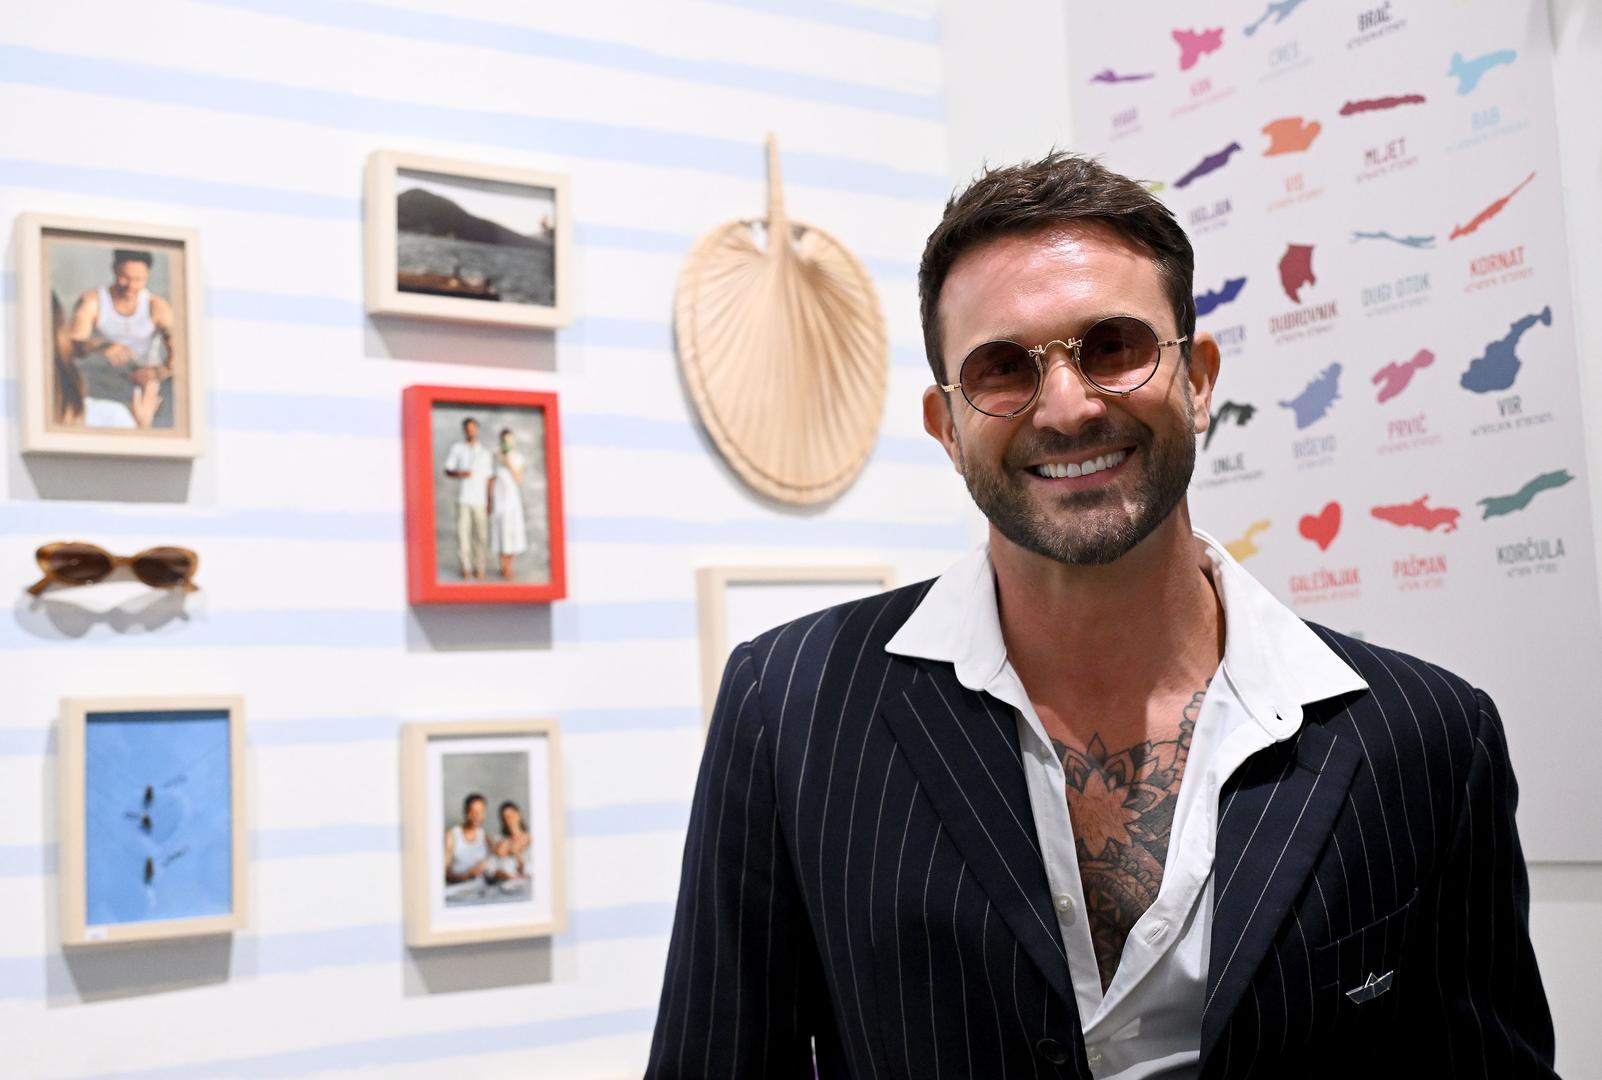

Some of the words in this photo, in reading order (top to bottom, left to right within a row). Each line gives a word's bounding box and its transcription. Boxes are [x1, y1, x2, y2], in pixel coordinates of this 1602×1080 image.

[1363, 137, 1406, 168] MLJET
[1469, 246, 1525, 277] KORNAT
[1268, 302, 1340, 336] DUBROVNIK
[1497, 394, 1522, 417] VIR
[1393, 554, 1447, 578] PAŠMAN
[1496, 536, 1566, 566] KORČULA
